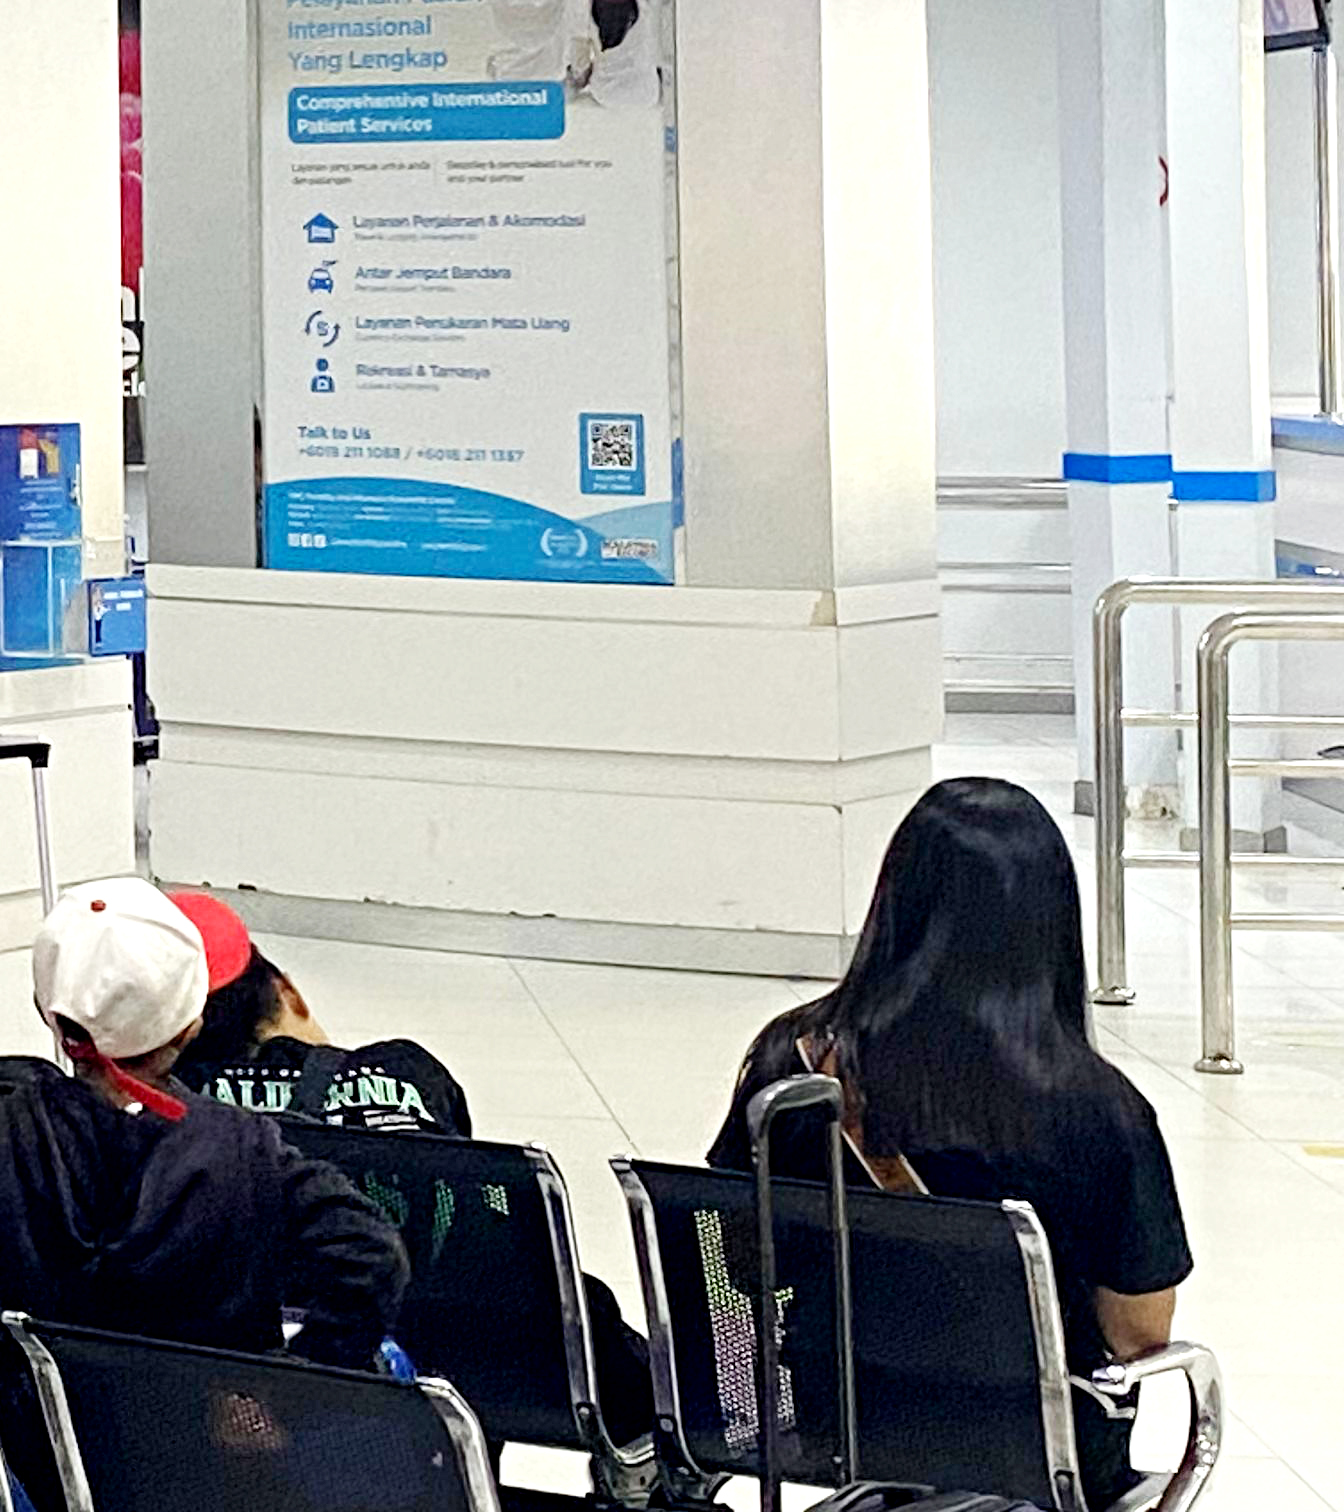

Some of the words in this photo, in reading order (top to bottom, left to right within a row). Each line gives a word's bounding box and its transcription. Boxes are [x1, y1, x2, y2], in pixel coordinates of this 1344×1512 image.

[287, 16, 432, 40] Internasional
[288, 51, 342, 74] Yang
[349, 48, 448, 73] Lengkap
[296, 93, 429, 113] Comprehensive
[432, 89, 548, 109] International
[296, 115, 357, 134] Patient
[360, 114, 433, 134] Services
[488, 215, 499, 228] &
[298, 425, 328, 439] Talk
[332, 427, 348, 439] to
[353, 427, 372, 440] Us
